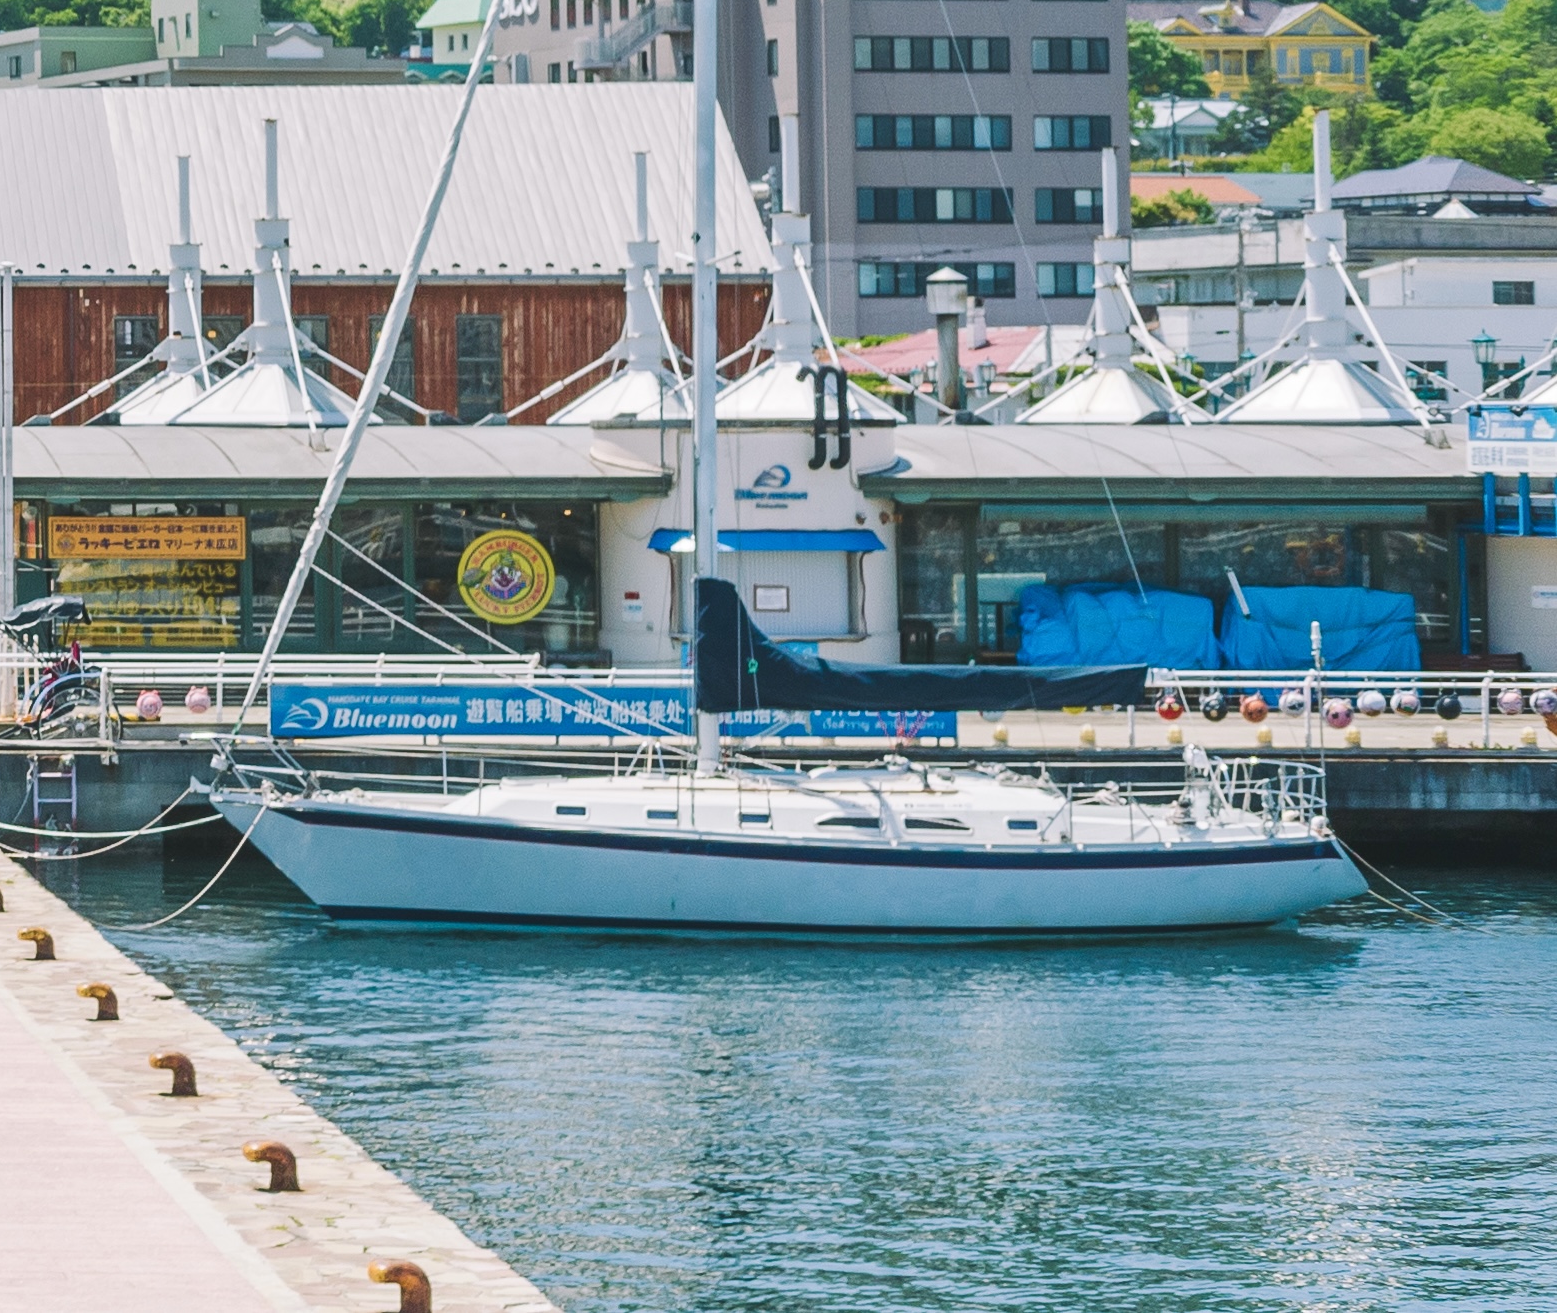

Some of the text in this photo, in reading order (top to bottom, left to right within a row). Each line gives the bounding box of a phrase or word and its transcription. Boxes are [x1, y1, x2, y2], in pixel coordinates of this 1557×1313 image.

[78, 537, 160, 550] ラッキーピエロ
[327, 695, 371, 704] HAKODATE
[372, 695, 389, 704] BAY
[390, 695, 418, 704] CRUISE
[333, 708, 458, 729] Bluemoon
